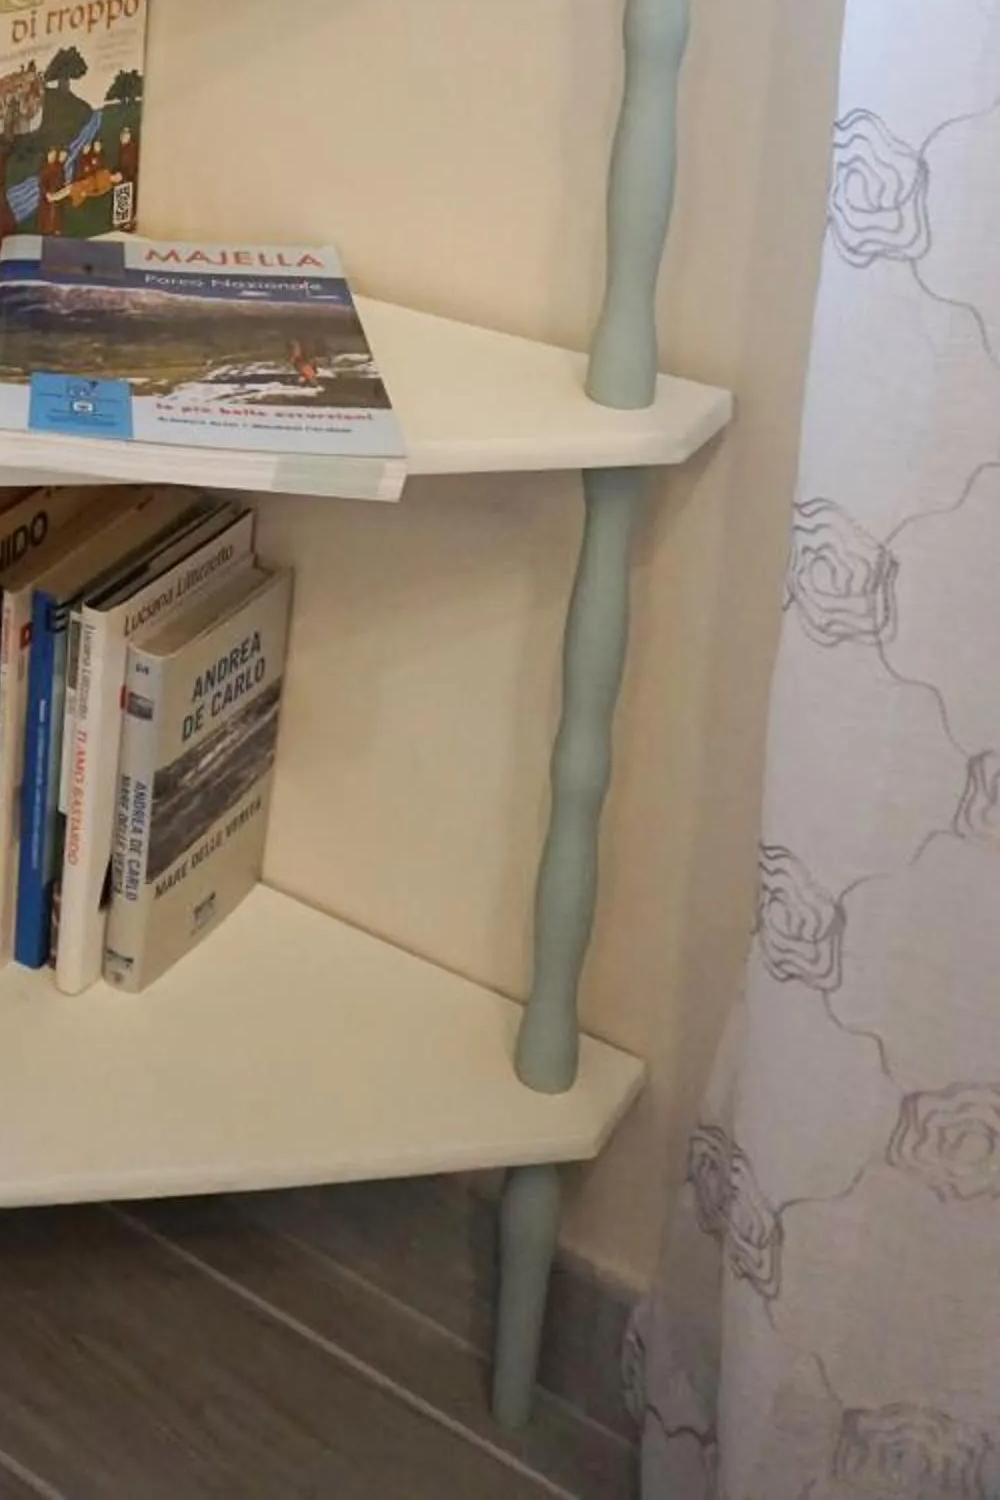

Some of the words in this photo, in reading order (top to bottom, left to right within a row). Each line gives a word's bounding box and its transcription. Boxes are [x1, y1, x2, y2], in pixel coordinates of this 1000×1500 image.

[11, 9, 37, 44] di
[145, 248, 325, 268] MAJELLA
[144, 273, 204, 288] Parco
[211, 277, 322, 291] Nazionale
[191, 630, 261, 703] ANDREA
[181, 702, 205, 743] DE
[211, 656, 266, 718] CARLO
[131, 781, 149, 837] ANDREA
[129, 839, 143, 856] DE
[126, 859, 142, 901] CARLO
